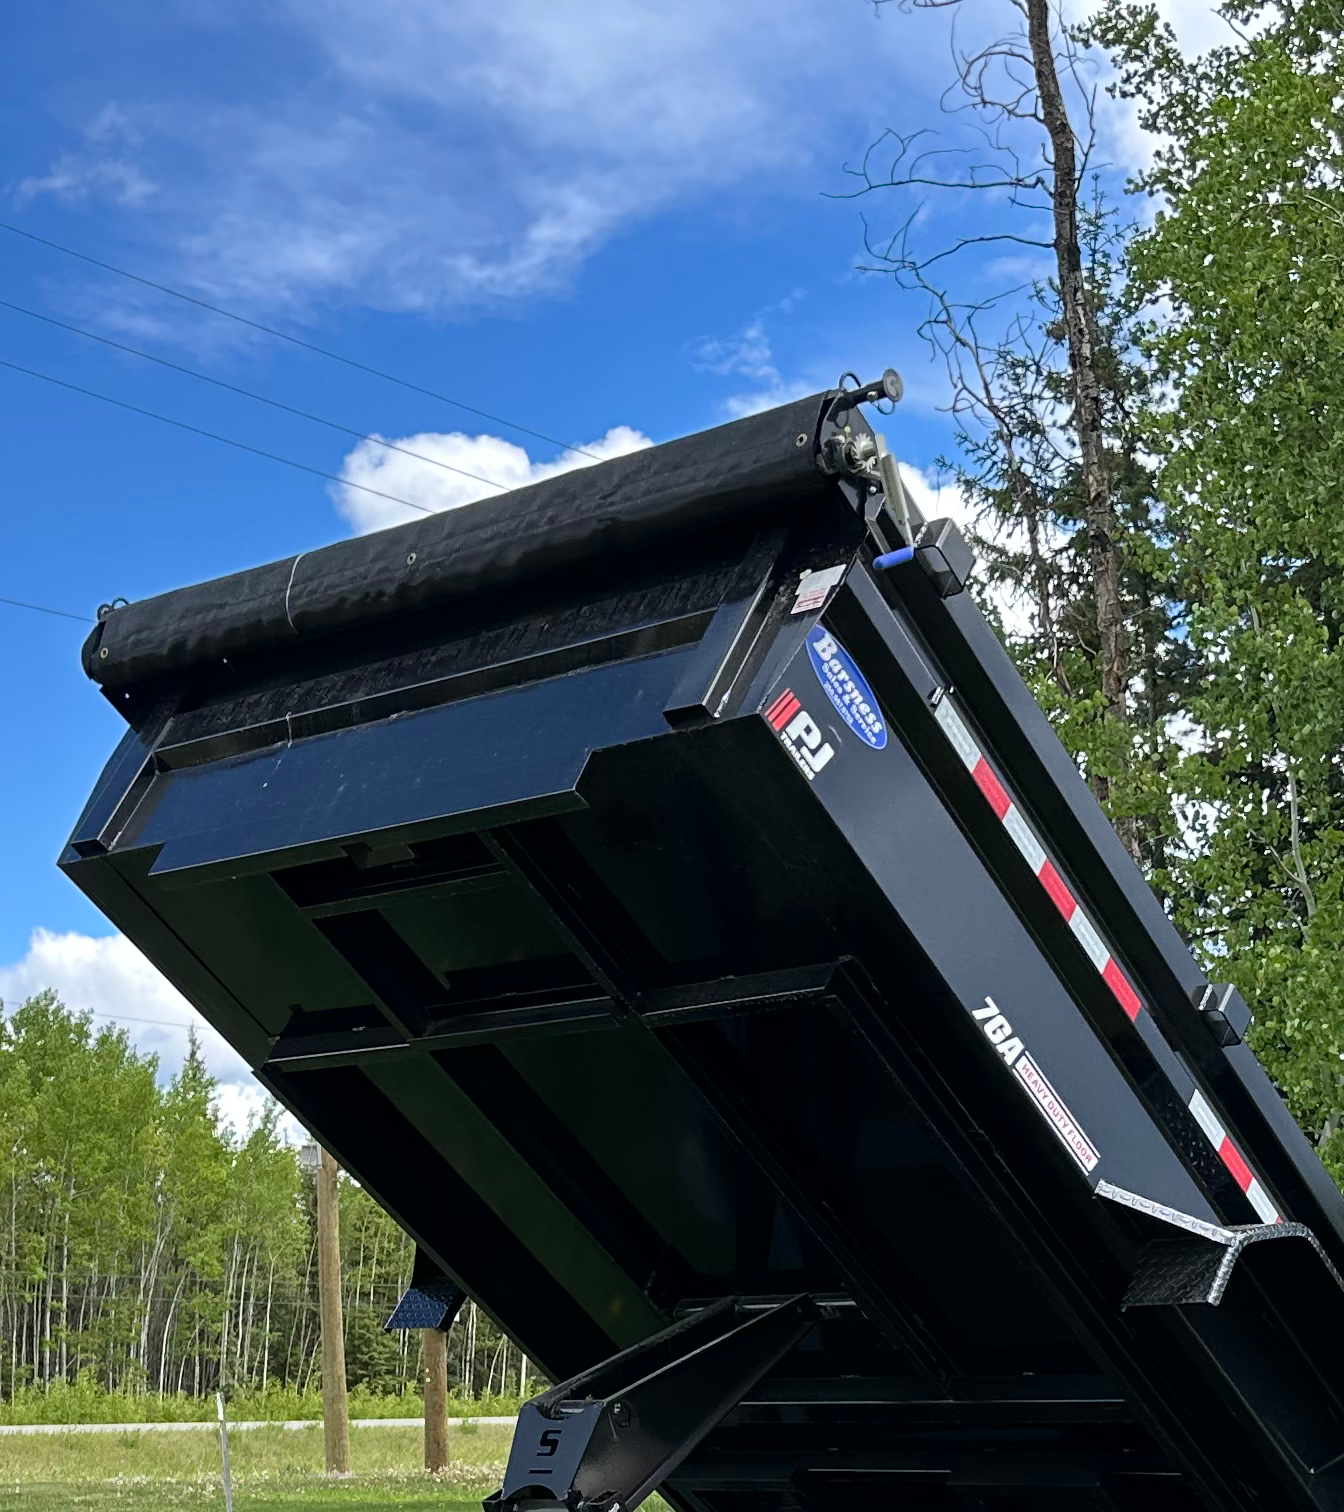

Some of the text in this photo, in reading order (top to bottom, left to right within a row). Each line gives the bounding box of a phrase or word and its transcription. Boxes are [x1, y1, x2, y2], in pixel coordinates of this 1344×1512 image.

[813, 633, 882, 734] Barsness
[822, 662, 876, 744] Sales & Service
[780, 731, 815, 780] TRAILERS
[785, 711, 834, 772] PJ
[972, 996, 1024, 1065] 7GA
[1021, 1064, 1093, 1163] HEAVY DUTY FLOOR
